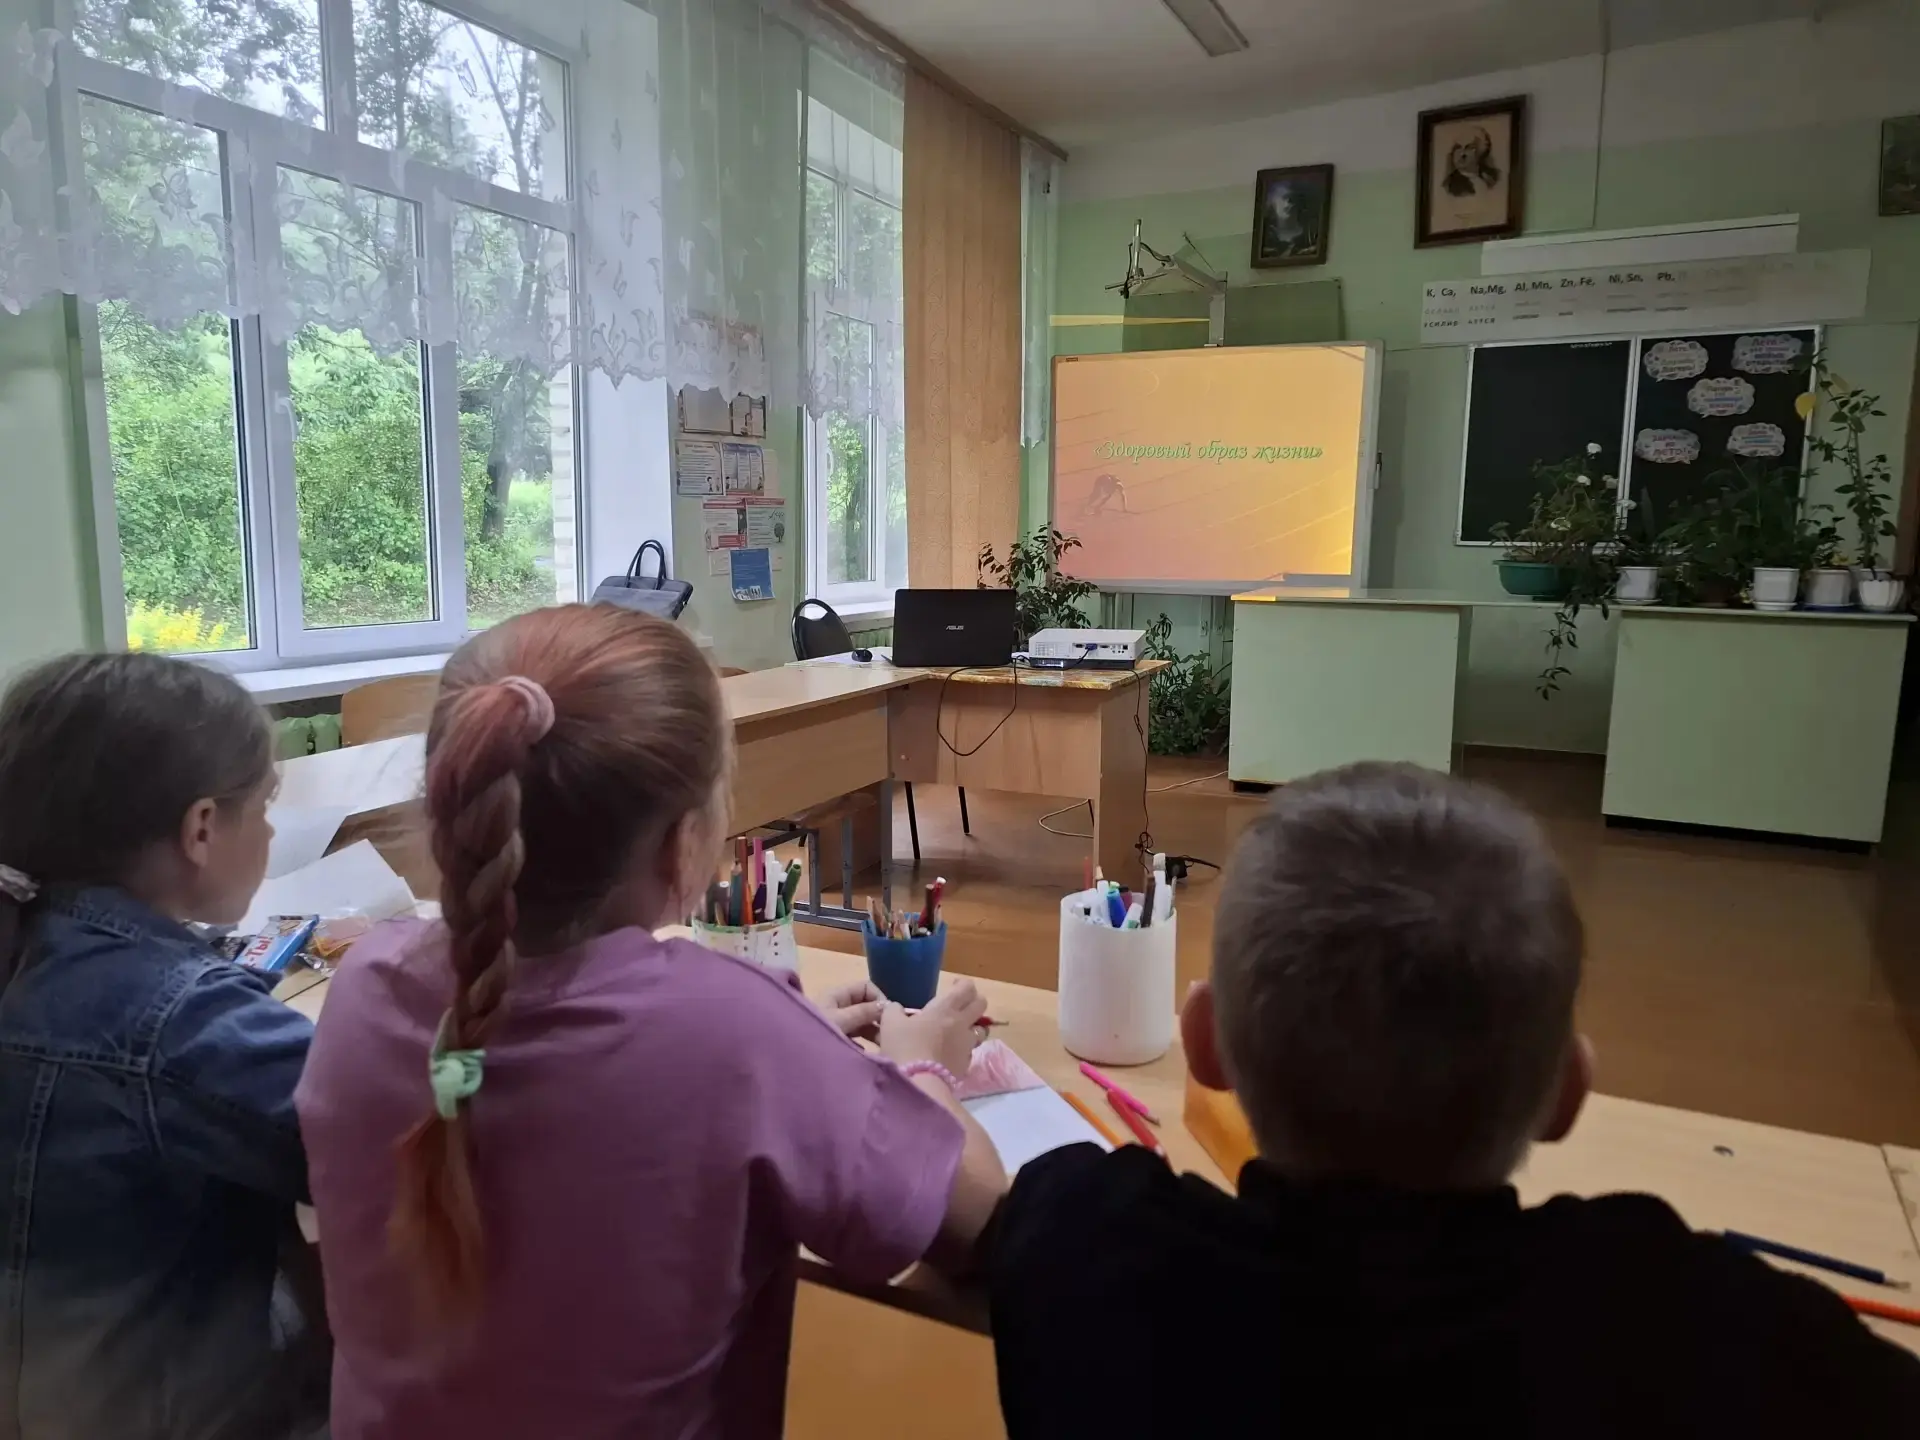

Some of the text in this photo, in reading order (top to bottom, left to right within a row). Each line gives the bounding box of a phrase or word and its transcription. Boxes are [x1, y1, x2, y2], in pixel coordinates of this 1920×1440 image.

[1426, 288, 1436, 298] K,
[1441, 287, 1457, 299] Ca,
[1514, 282, 1529, 292] Al,
[1531, 281, 1553, 291] Mn,
[1560, 278, 1577, 288] Zn,
[1579, 277, 1596, 287] Fe,
[1608, 274, 1624, 284] Ni,
[1626, 273, 1644, 283] Sn,
[1094, 440, 1324, 465] «Здоровый образ жизни»
